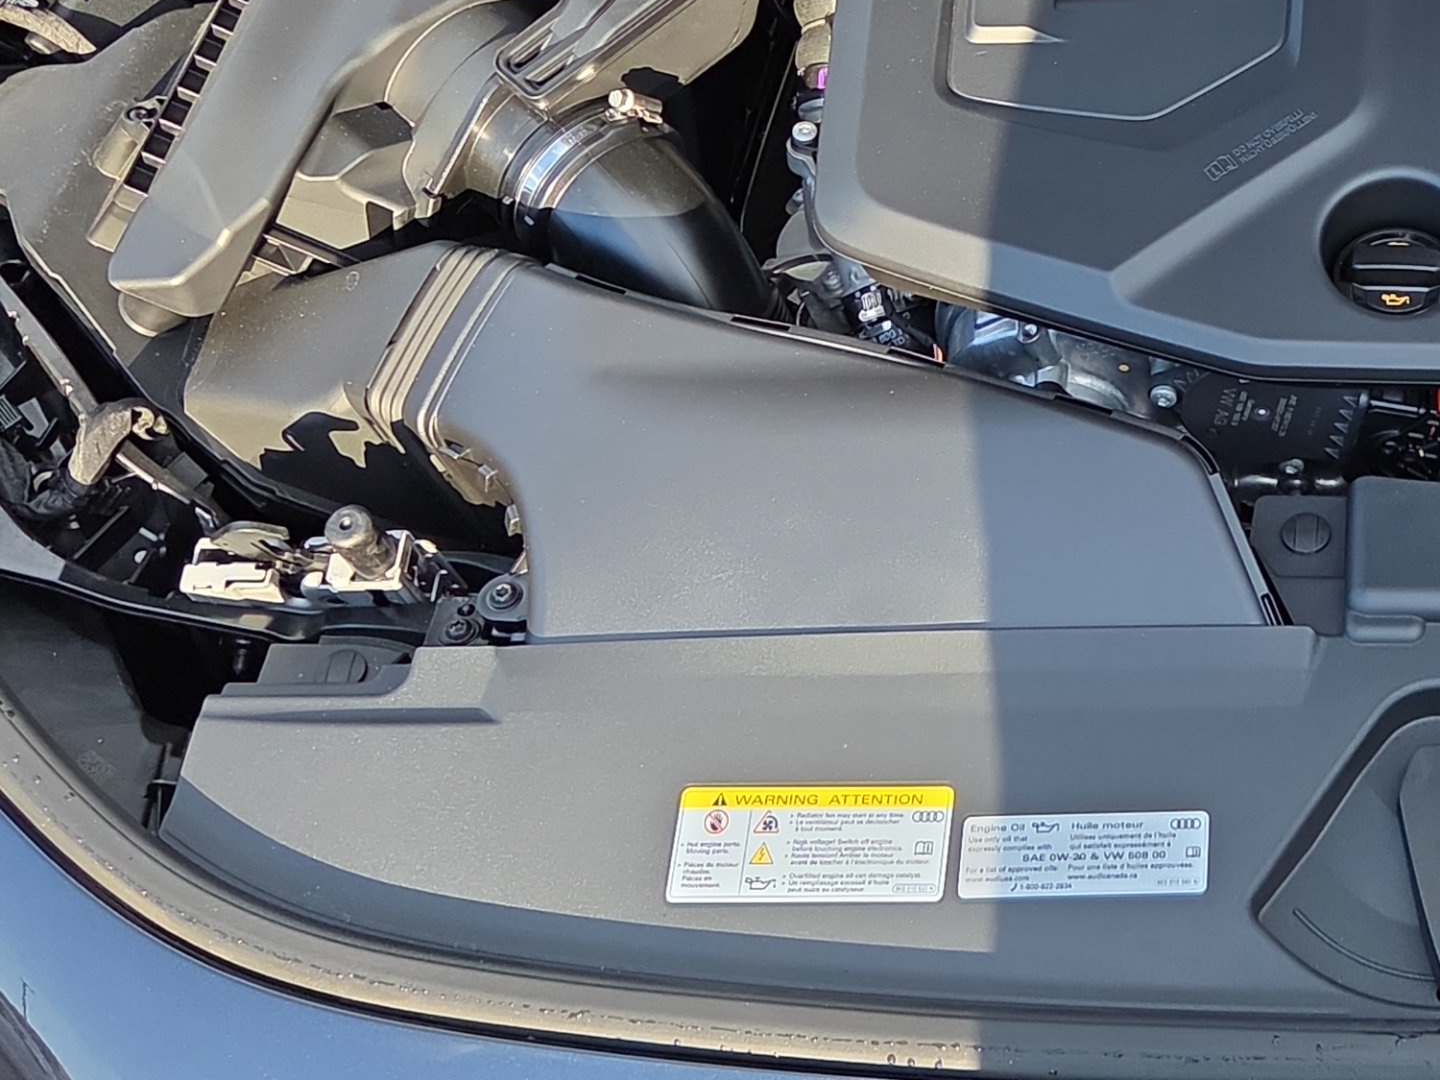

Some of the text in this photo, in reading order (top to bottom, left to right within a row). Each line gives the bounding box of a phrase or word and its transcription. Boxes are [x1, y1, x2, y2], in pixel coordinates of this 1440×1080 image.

[735, 793, 924, 805] WARNING ATTENTION
[970, 823, 1025, 834] Engine Oil
[1071, 821, 1144, 830] Huile moteur
[984, 836, 1001, 844] only
[967, 845, 1001, 854] expressly
[1037, 843, 1052, 851] with
[1022, 853, 1046, 862] SAE
[1049, 851, 1087, 861] 0W-20
[1090, 851, 1100, 861] &
[1103, 851, 1124, 860] VW
[1151, 850, 1167, 860] 00
[1007, 865, 1042, 874] approved
